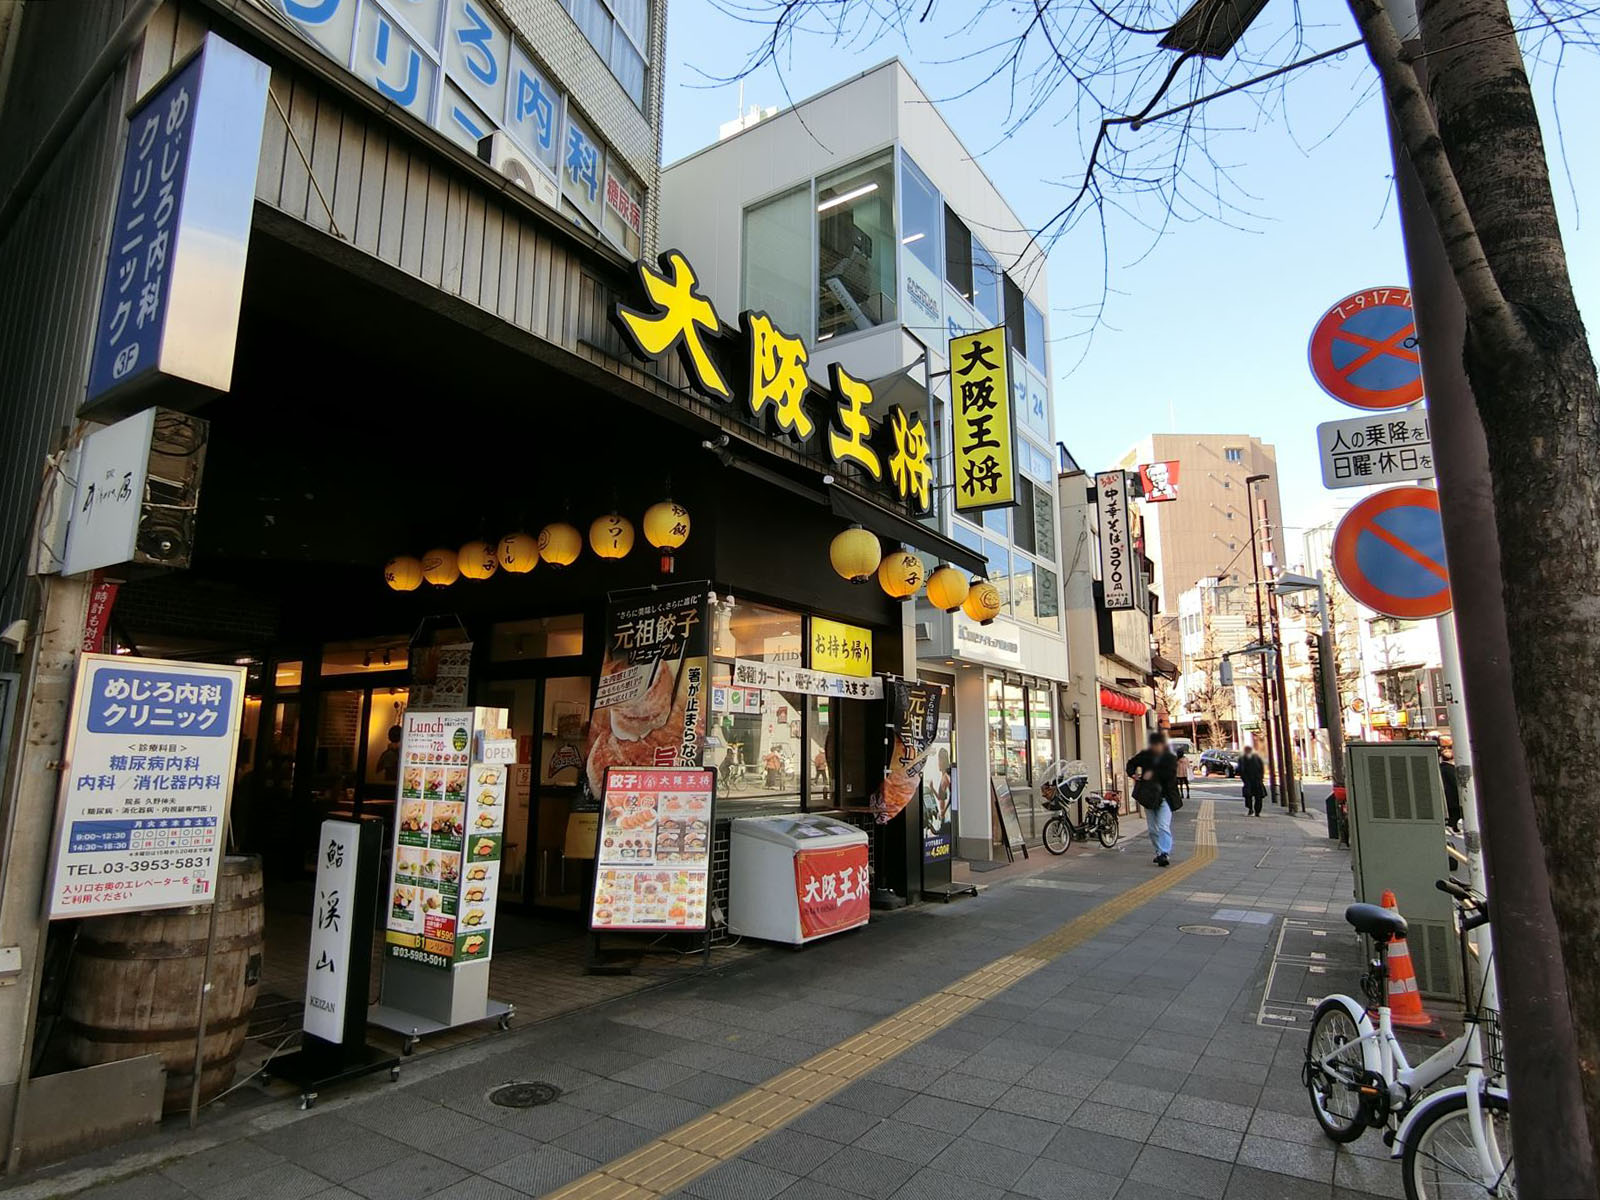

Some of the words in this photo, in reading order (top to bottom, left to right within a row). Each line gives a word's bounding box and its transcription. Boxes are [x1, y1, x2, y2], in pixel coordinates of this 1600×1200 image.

[136, 87, 190, 330] めじろ内科
[606, 174, 641, 234] 糖尿病
[110, 114, 161, 348] クリニック
[115, 345, 139, 378] 3F
[617, 250, 934, 512] 大阪王将
[955, 340, 1003, 498] 大阪王将
[1330, 419, 1431, 453] 人の乗降を
[902, 556, 921, 585] 餃子
[613, 609, 700, 650] 元祖餃子
[629, 641, 680, 664] リニューアル
[815, 634, 870, 665] お持ち帰り
[103, 678, 222, 708] めじろ内科
[103, 703, 220, 733] クリニック
[409, 717, 444, 733] Lunch
[109, 755, 201, 773] 糖尿病内科
[485, 747, 515, 763] OPEN
[66, 857, 212, 876] TEL.03-3953-5831
[61, 892, 132, 906] ご利用ください
[803, 865, 870, 907] 大阪王将
[399, 947, 447, 967] 03-5983-5011
[310, 995, 336, 1014] KEIZAN
